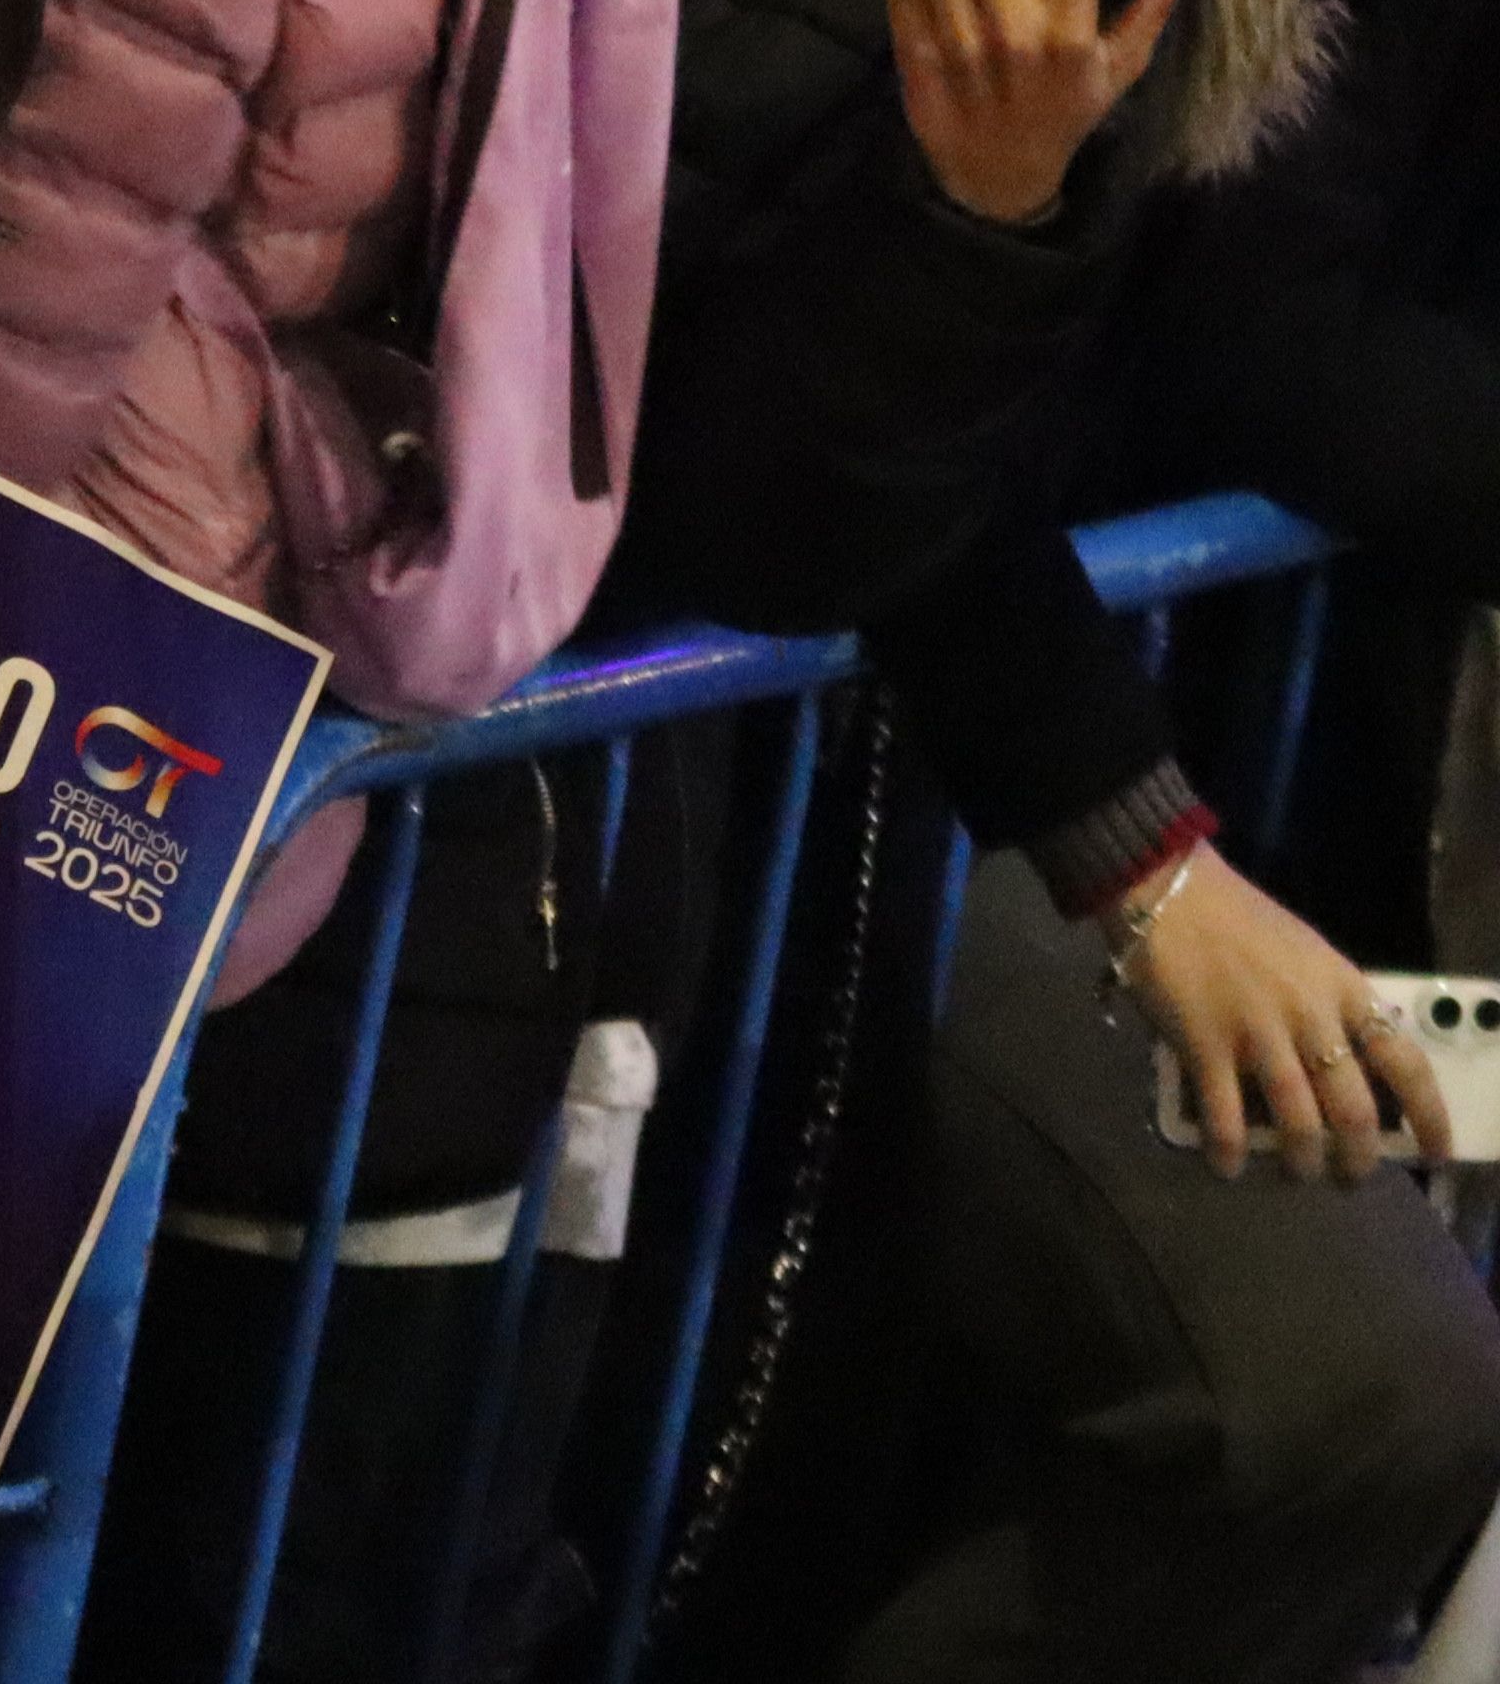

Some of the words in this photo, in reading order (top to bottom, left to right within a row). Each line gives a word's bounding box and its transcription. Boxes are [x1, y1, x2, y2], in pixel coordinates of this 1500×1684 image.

[74, 705, 226, 819] OT
[48, 797, 179, 885] TRIUNFO
[52, 780, 189, 865] OPERACIÓN
[23, 830, 165, 929] 2025
